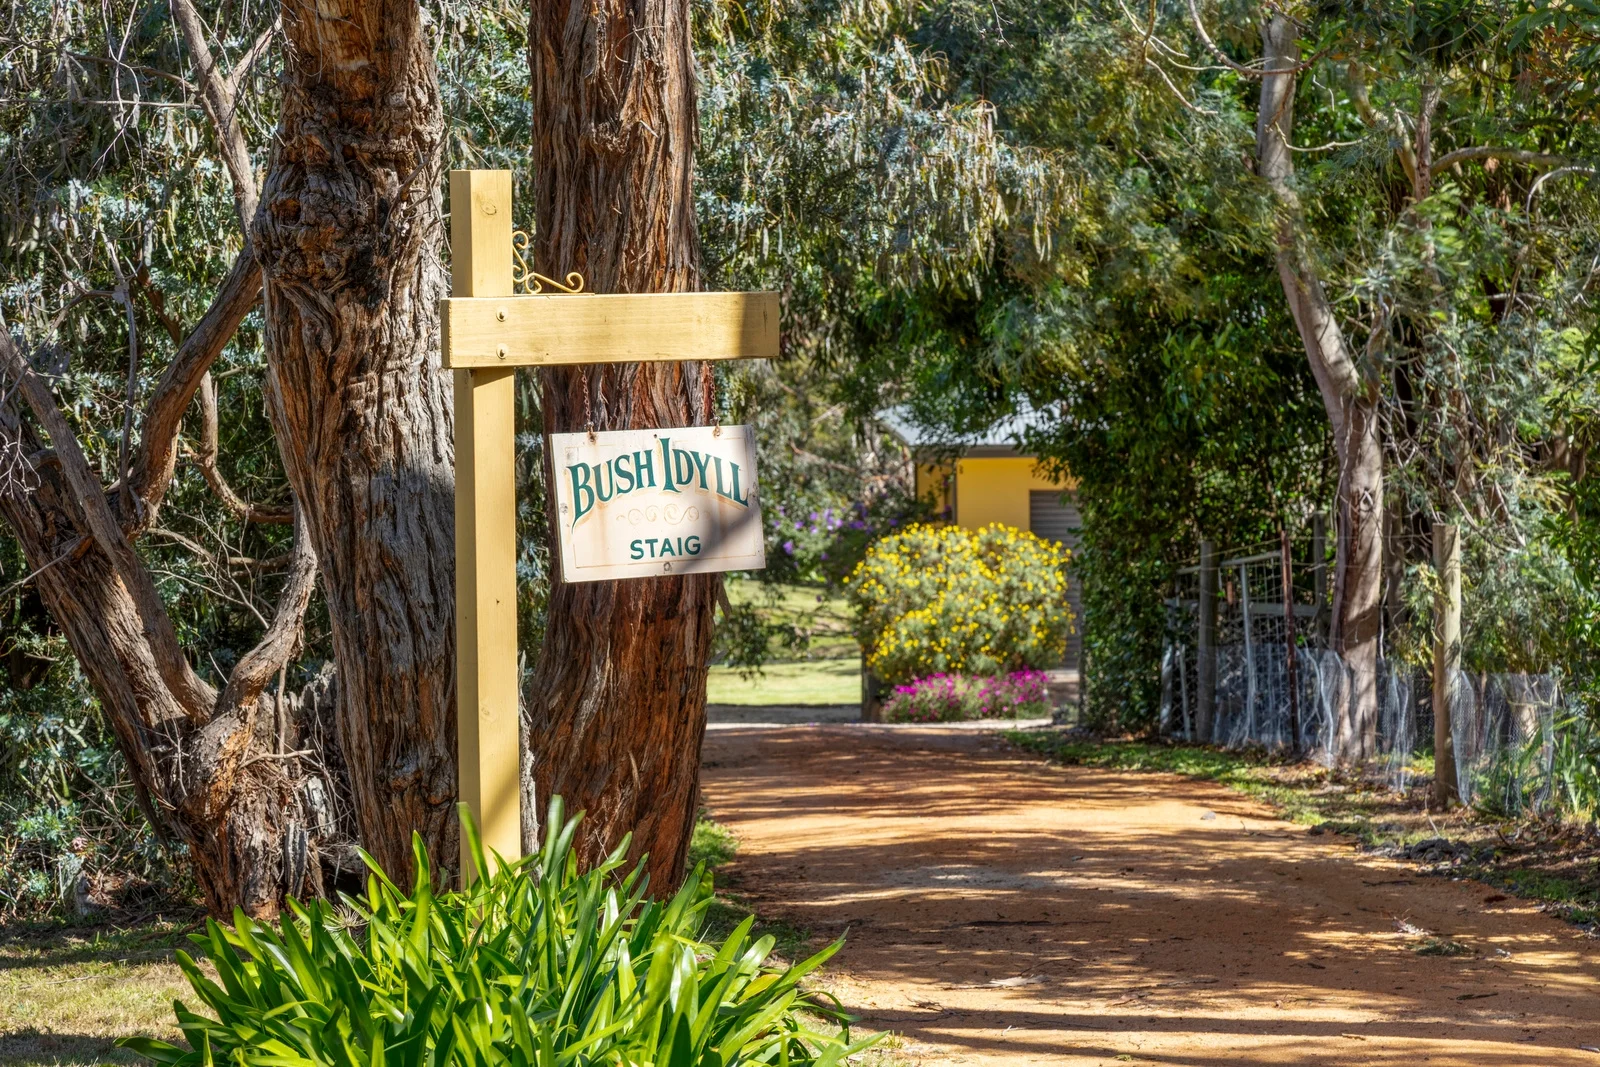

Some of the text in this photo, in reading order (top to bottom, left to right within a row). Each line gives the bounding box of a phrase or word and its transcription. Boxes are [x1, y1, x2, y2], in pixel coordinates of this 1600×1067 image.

[567, 437, 749, 534] BUSH IDYLL
[630, 535, 701, 560] STAIG
